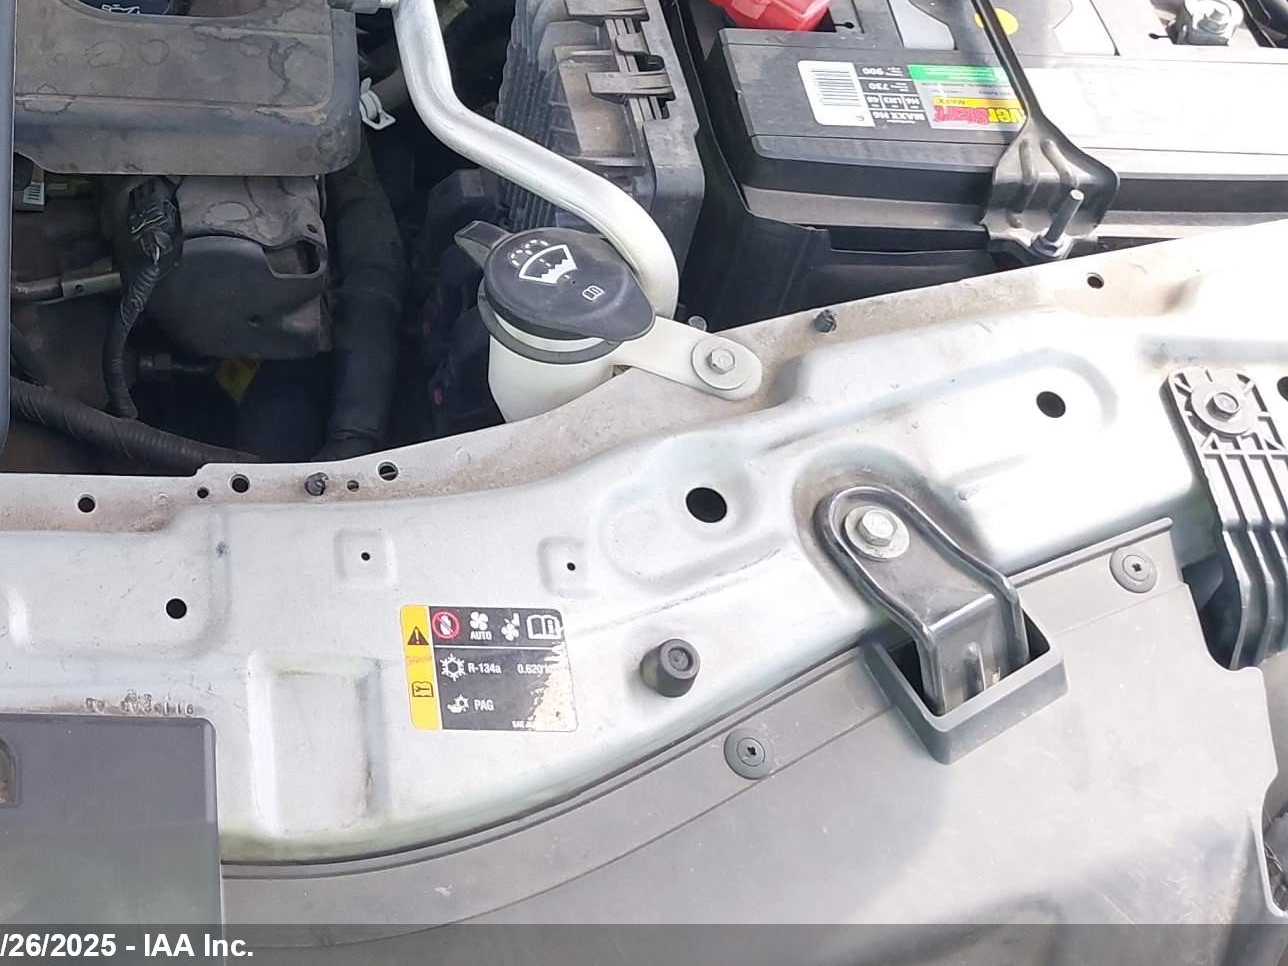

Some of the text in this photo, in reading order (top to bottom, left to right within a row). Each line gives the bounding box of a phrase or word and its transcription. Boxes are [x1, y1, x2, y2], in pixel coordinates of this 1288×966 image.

[934, 106, 1024, 126] verStart
[470, 631, 492, 640] AUTO
[468, 662, 502, 674] R-134a
[517, 663, 544, 674] 0.620
[474, 700, 495, 711] PAG
